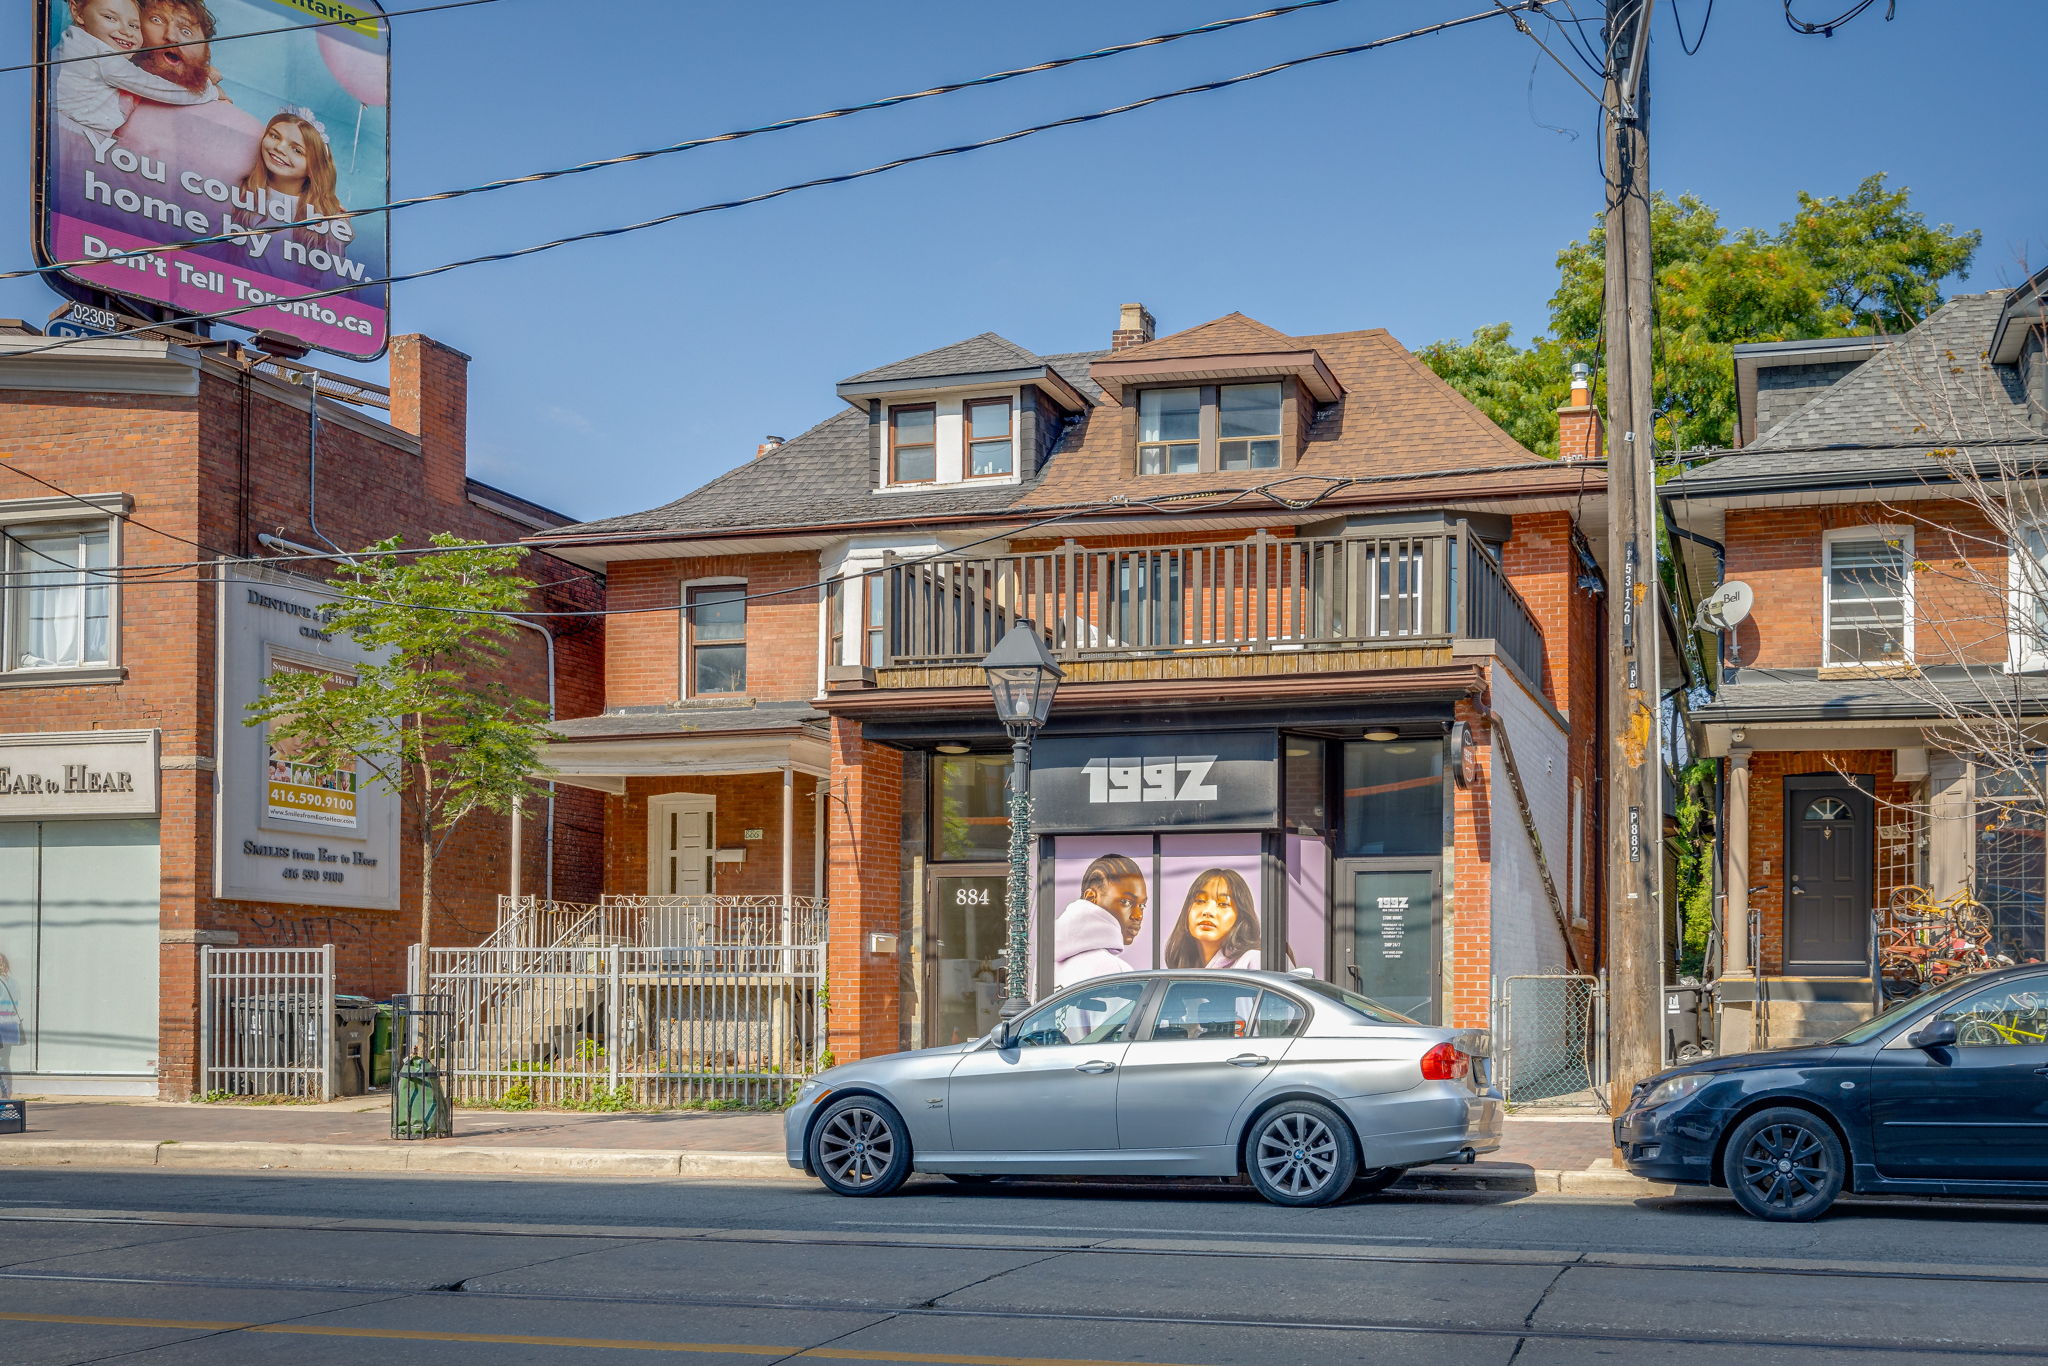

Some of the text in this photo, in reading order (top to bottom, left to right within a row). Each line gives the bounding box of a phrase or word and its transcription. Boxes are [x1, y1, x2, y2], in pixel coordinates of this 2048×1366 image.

[83, 129, 353, 242] You could be
[85, 170, 209, 234] home
[222, 213, 272, 258] by
[74, 304, 116, 327] 0230B
[174, 260, 224, 294] Tell
[232, 278, 372, 336] Toronto.ca
[1624, 562, 1632, 625] 53120
[1723, 591, 1740, 603] Bell
[45, 778, 60, 794] to
[63, 764, 134, 793] HEAR
[1081, 755, 1219, 803] 199Z
[271, 788, 354, 811] 416.590.9100
[1630, 812, 1639, 857] P882
[956, 889, 990, 905] 884
[1377, 897, 1409, 908] 199Z
